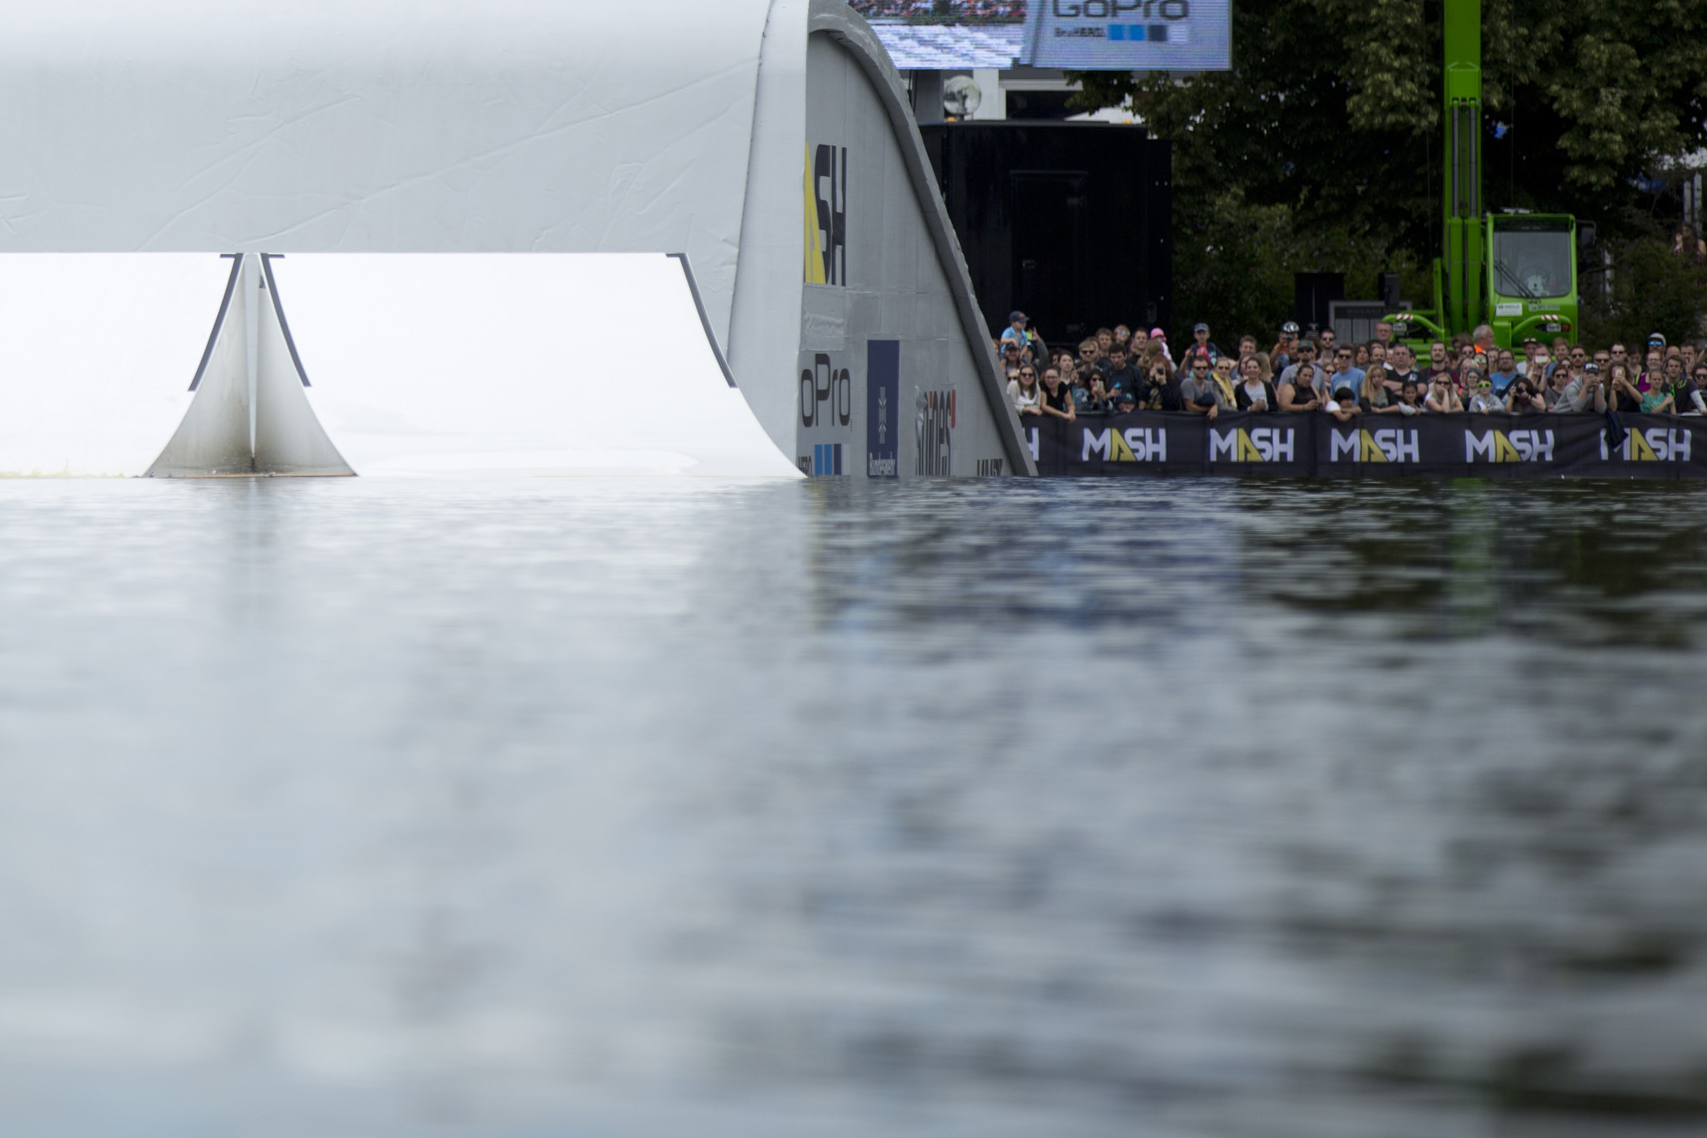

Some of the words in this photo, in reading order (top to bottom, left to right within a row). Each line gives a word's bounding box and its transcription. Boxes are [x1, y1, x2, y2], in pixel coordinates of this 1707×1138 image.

[1082, 427, 1167, 462] MASH
[1209, 427, 1295, 462] MASH
[1330, 428, 1420, 463] MASH
[1464, 429, 1555, 463] MASH
